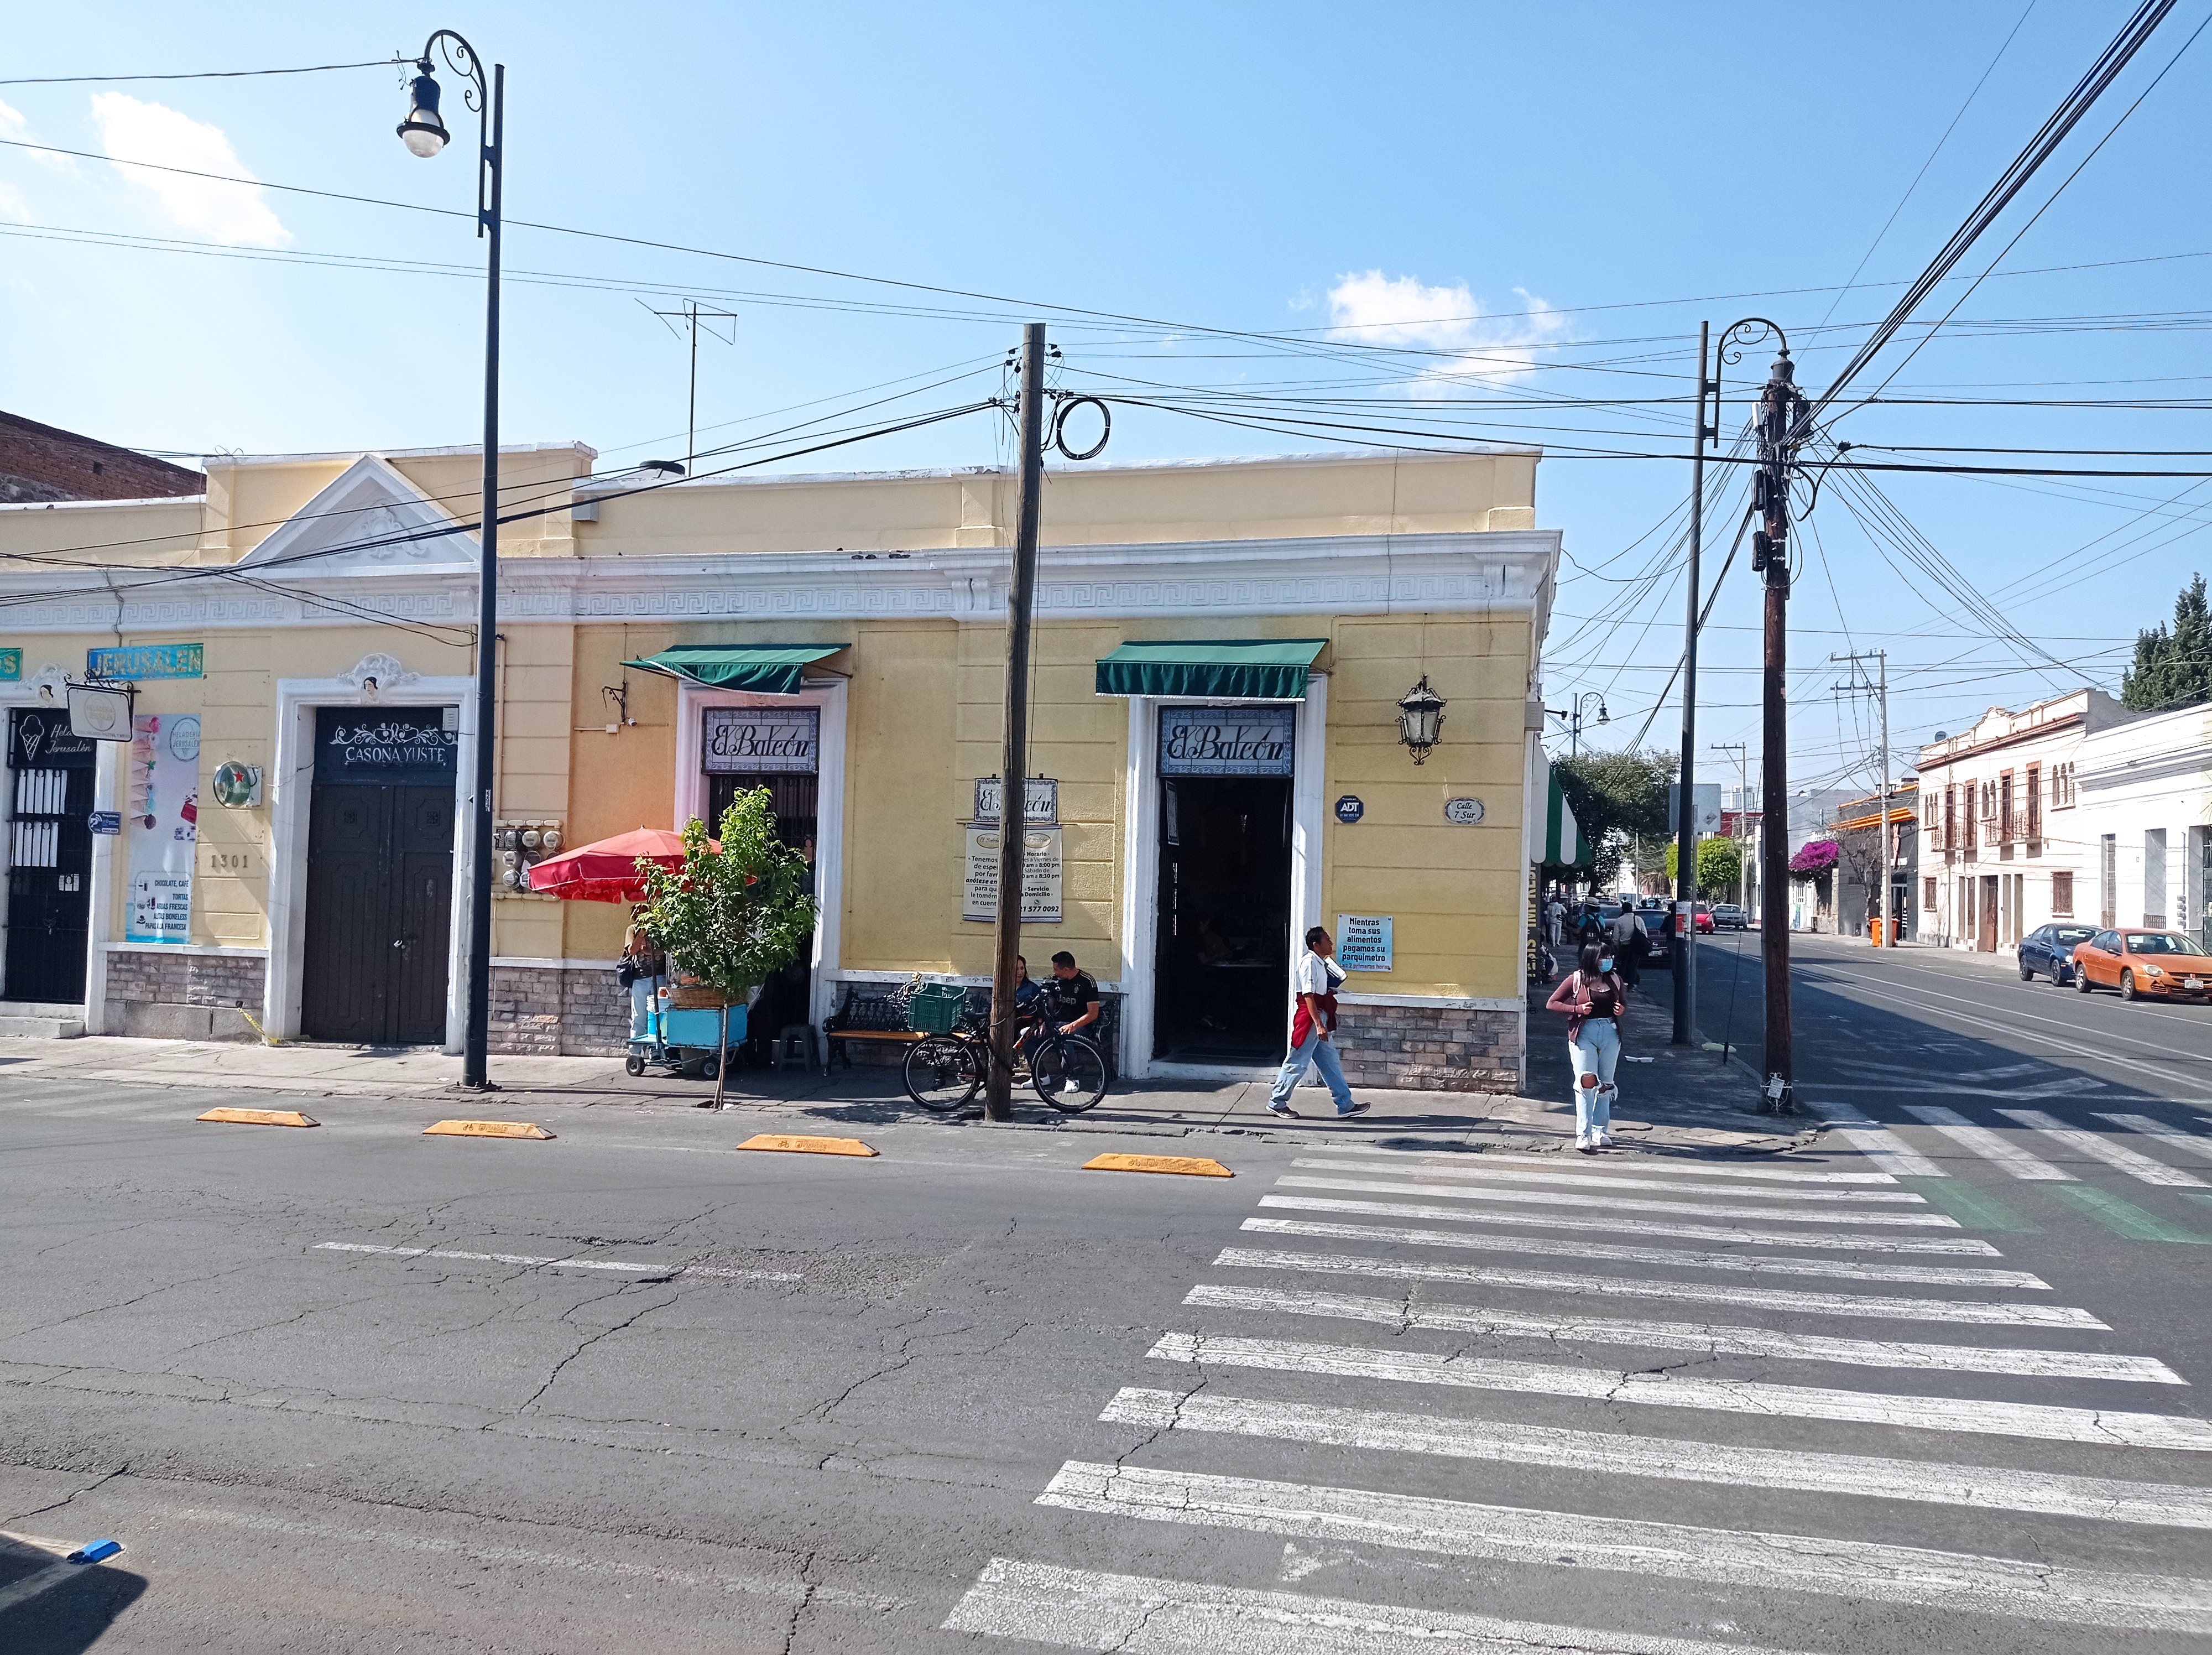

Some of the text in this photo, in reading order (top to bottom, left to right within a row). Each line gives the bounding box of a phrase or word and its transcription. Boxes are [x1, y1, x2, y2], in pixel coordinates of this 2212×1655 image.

[92, 649, 202, 676] JERUSALEN
[45, 740, 92, 753] Jerusalén
[712, 725, 809, 757] El Balcón
[1167, 725, 1284, 760] El Balcón
[346, 747, 445, 762] CASONA YUSTE
[980, 789, 993, 811] El
[1340, 802, 1359, 812] ADT
[211, 855, 248, 868] 1301
[179, 879, 189, 887] CAFÉ
[1349, 917, 1380, 926] Mientras
[1347, 935, 1382, 943] alimentos
[1343, 945, 1375, 953] pagamos
[1057, 994, 1076, 1005] Jeep
